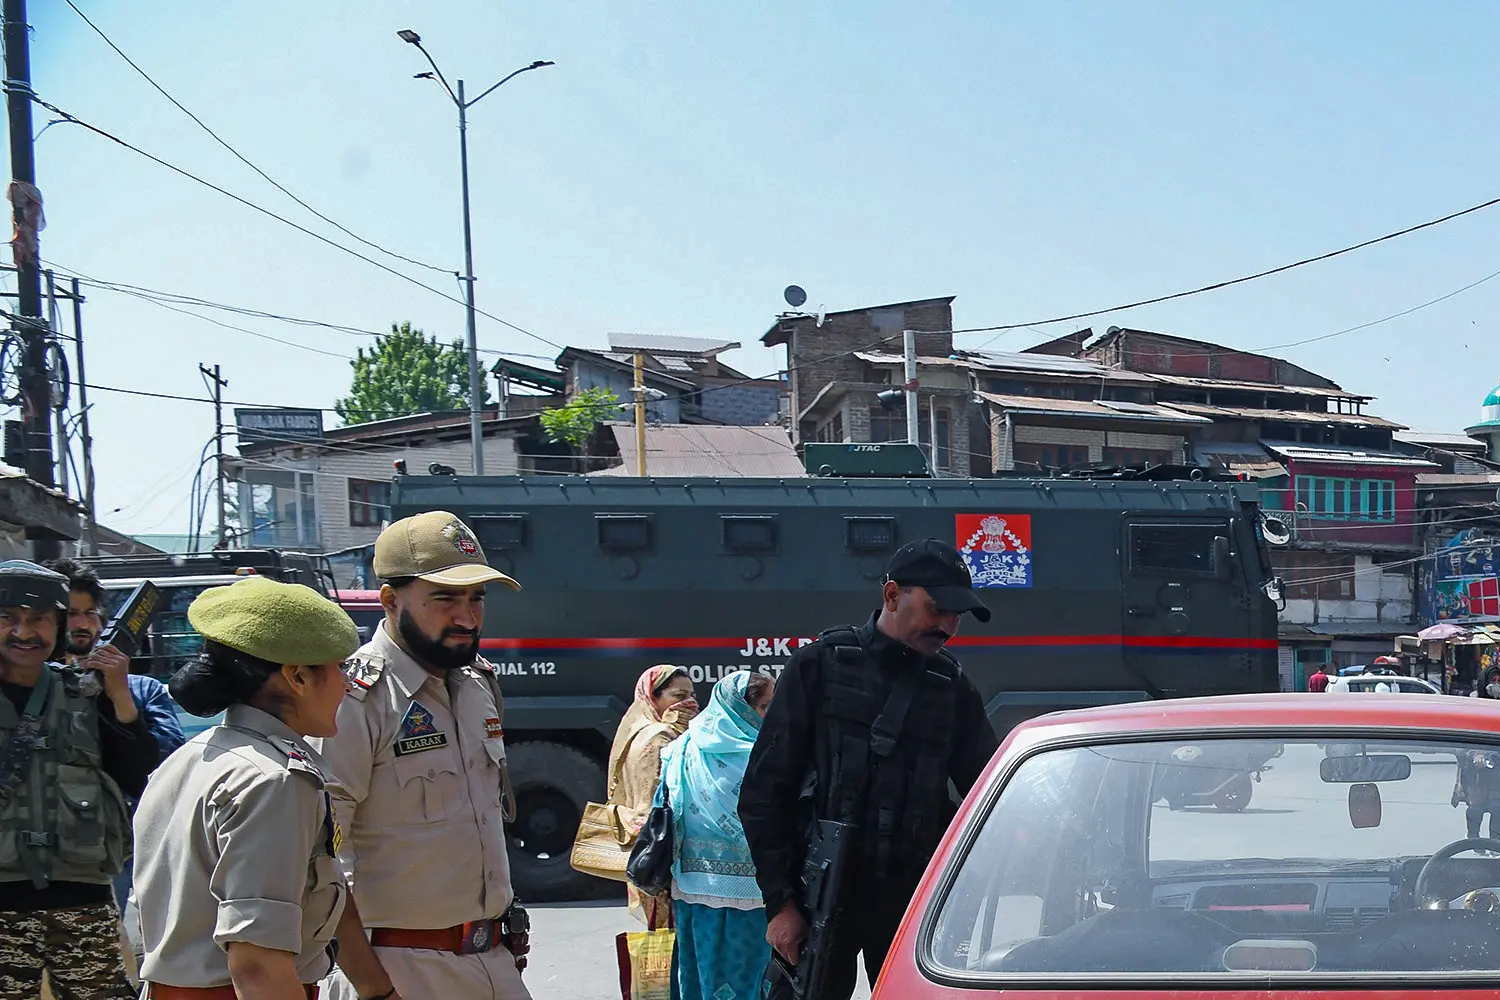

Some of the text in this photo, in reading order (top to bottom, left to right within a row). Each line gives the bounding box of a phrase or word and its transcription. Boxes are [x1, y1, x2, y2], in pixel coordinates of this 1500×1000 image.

[740, 637, 792, 657] J&K
[530, 662, 556, 675] 112
[406, 735, 442, 750] KARAN
